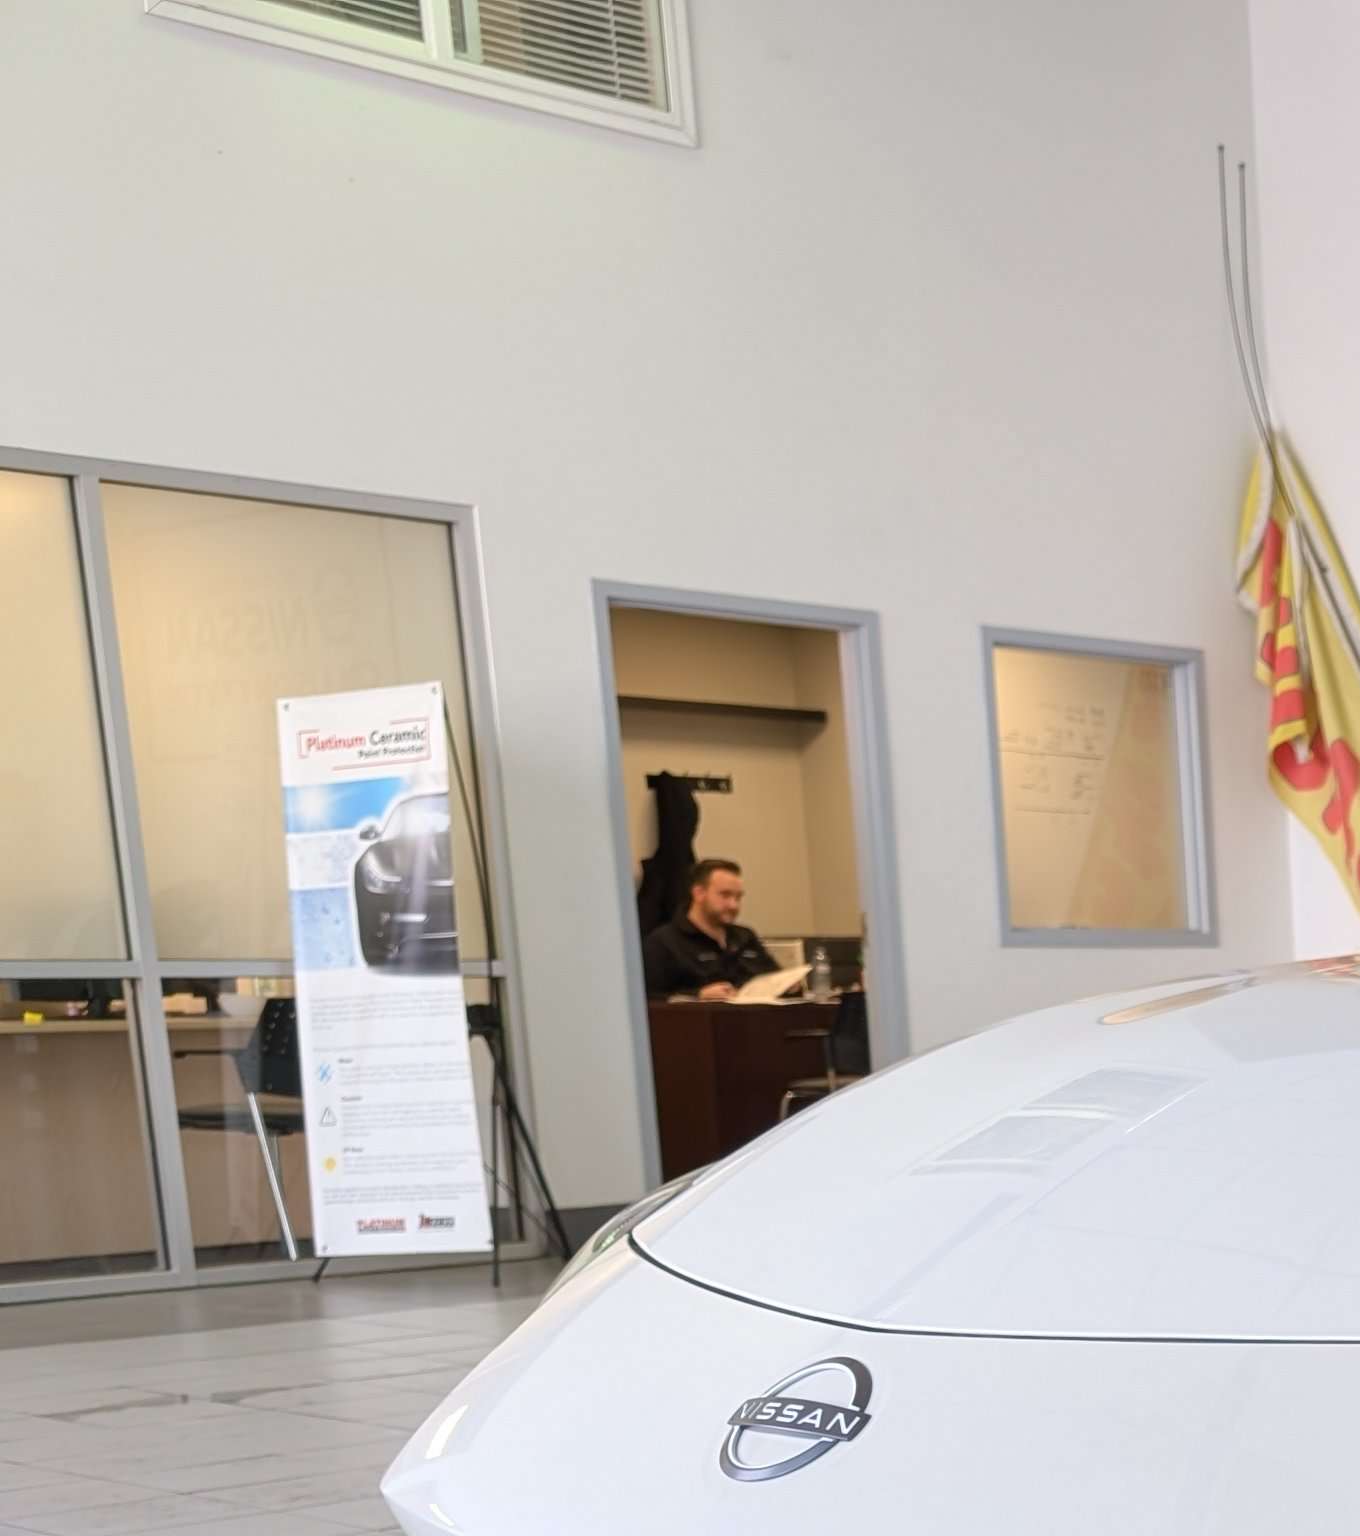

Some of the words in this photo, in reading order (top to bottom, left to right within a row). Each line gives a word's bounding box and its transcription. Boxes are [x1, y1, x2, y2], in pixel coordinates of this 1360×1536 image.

[306, 734, 366, 751] Platinum
[369, 726, 426, 746] Ceramic
[740, 1402, 861, 1436] NISSAN
